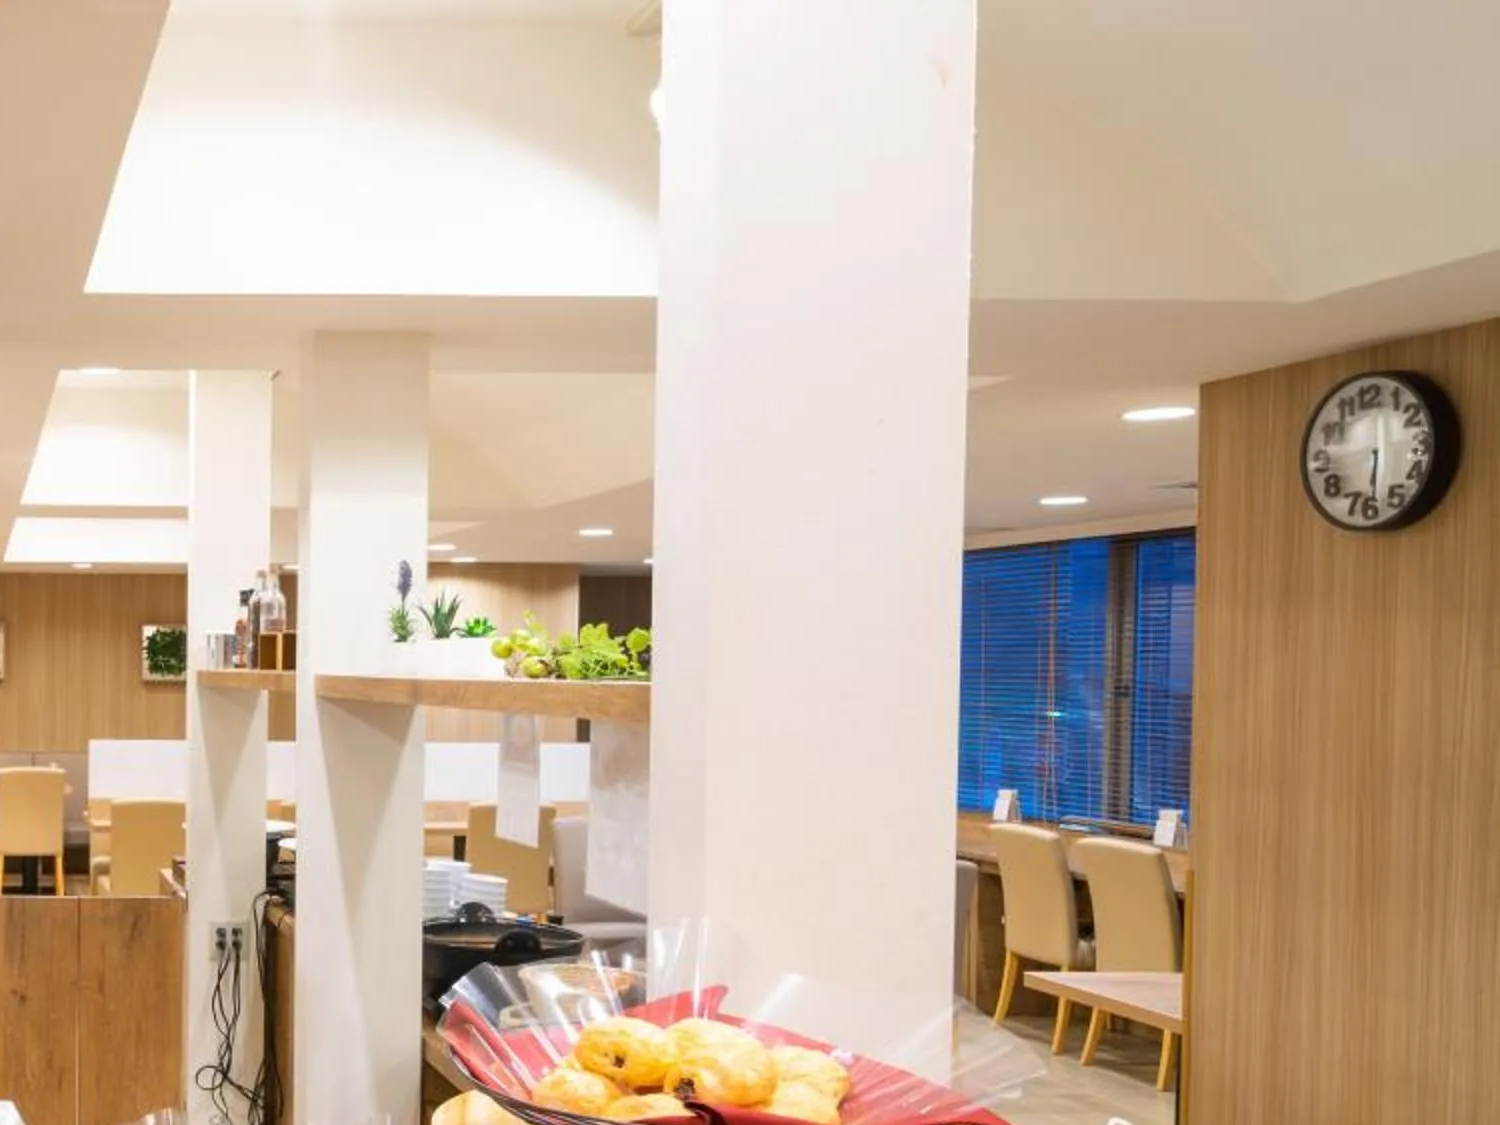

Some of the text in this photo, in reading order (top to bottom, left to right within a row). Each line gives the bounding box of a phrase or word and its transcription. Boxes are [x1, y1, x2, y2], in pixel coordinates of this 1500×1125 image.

[1337, 396, 1355, 420] 11
[1358, 383, 1381, 411] 12
[1390, 386, 1401, 411] 1
[1402, 403, 1422, 428] 2
[1322, 421, 1345, 446] 10
[1312, 449, 1330, 473] 9
[1405, 459, 1426, 483] 4
[1323, 473, 1341, 498] 8
[1386, 484, 1405, 509] 5
[1343, 491, 1362, 516] 7
[1361, 496, 1379, 520] 6
